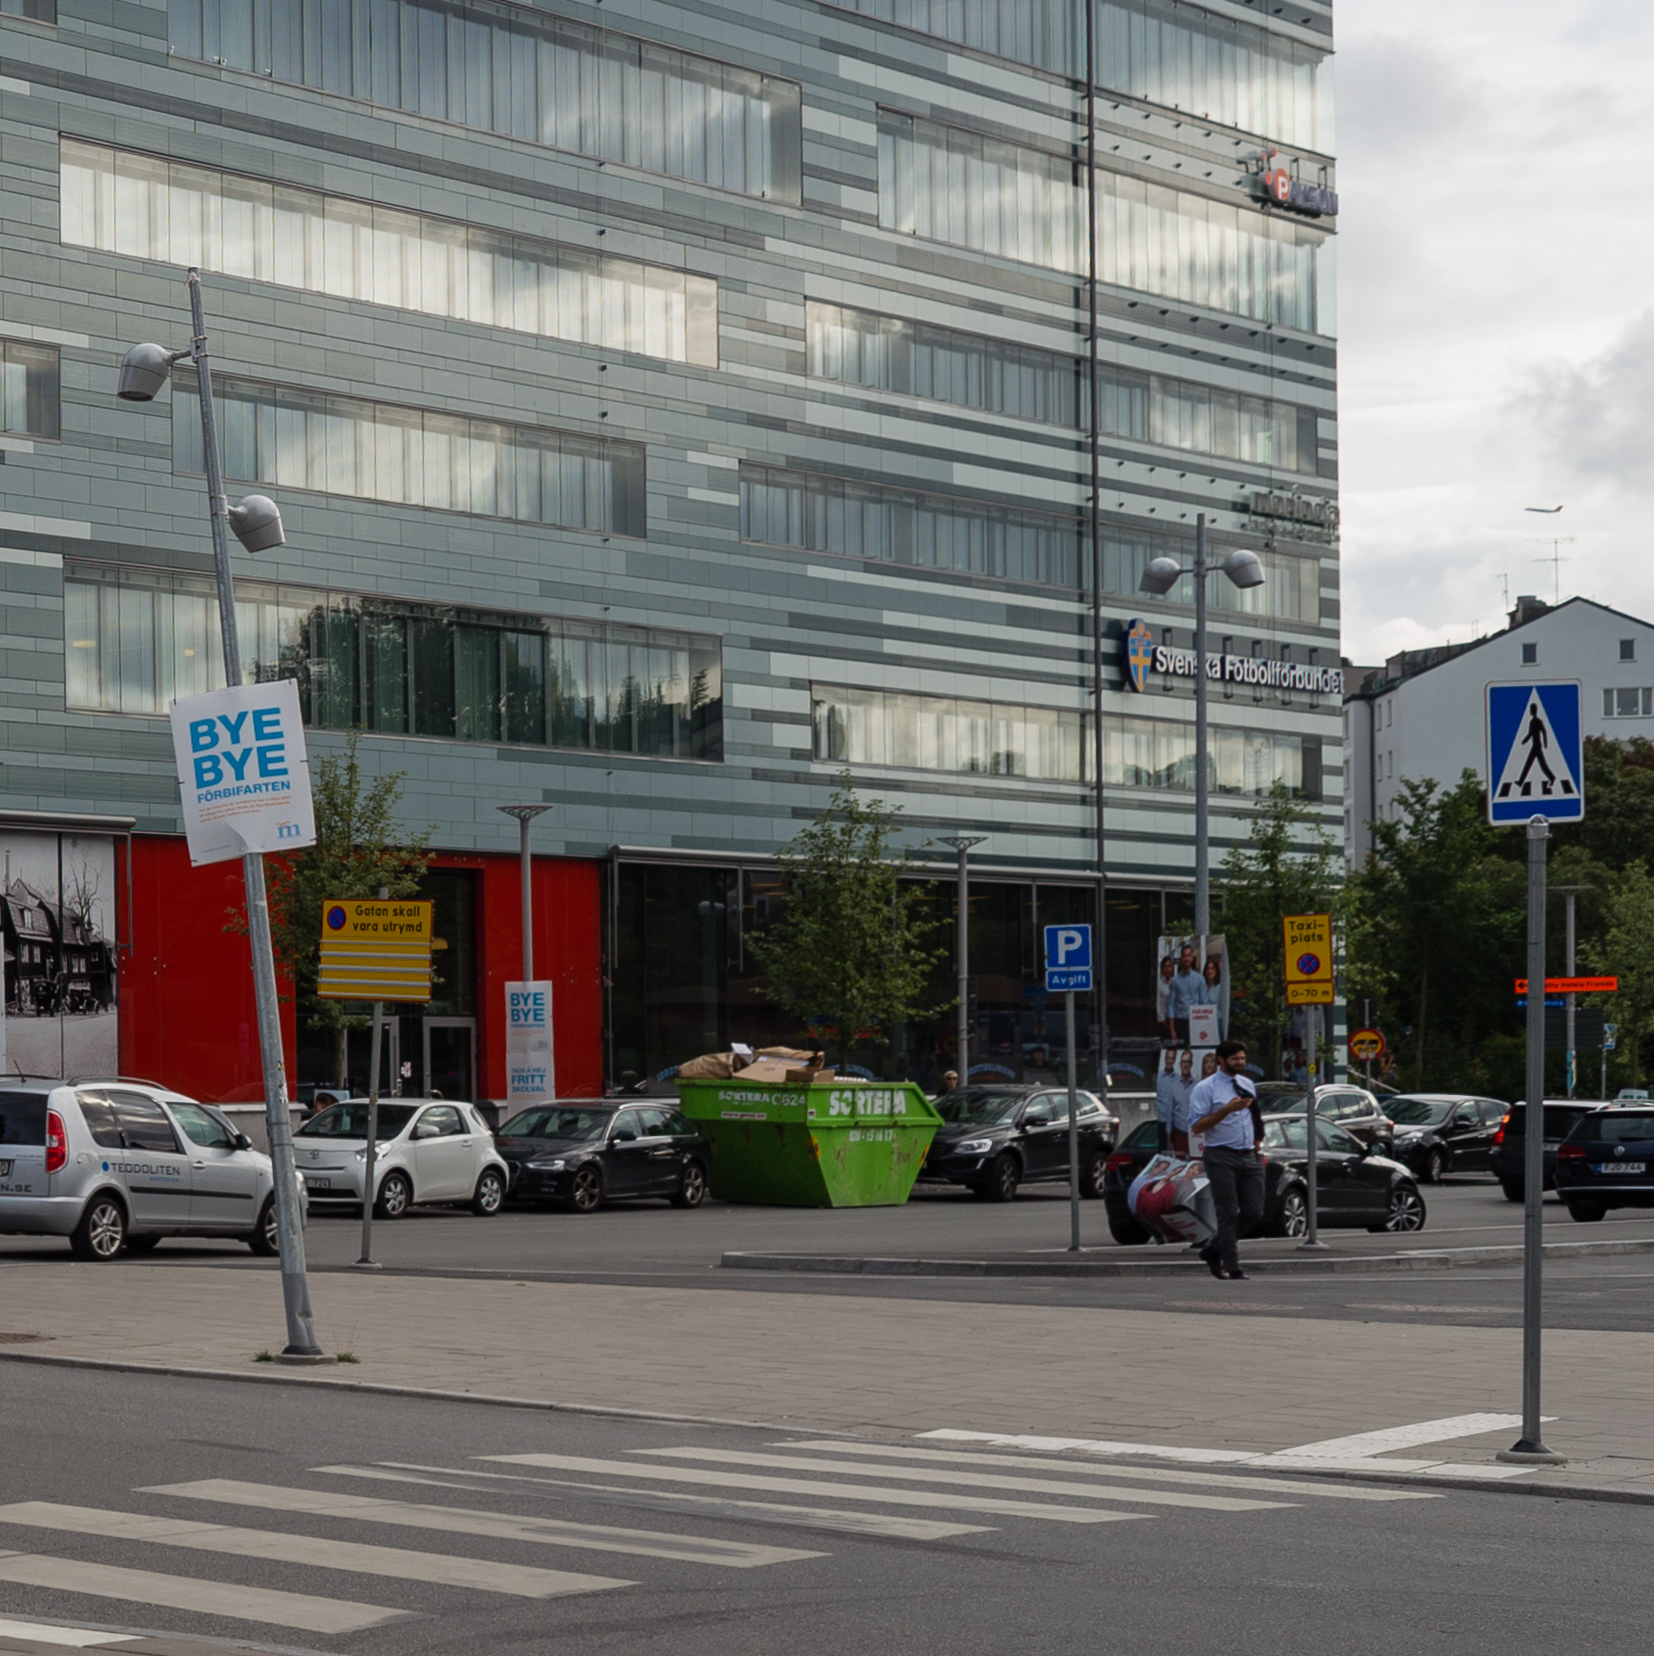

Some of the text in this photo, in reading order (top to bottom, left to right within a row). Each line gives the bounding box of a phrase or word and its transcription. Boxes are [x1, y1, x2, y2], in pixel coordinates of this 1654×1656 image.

[1224, 654, 1345, 694] Fotbollförbundet
[189, 707, 285, 753] BYE
[193, 744, 289, 790] BYE
[197, 780, 291, 804] FÖRBIFARTEN
[355, 905, 421, 917] Gatan skall
[353, 922, 423, 934] vara utrymd
[1289, 920, 1325, 931] Taxi-
[1291, 933, 1324, 945] plats
[1057, 930, 1083, 965] P
[1052, 975, 1087, 986] Avgift
[510, 992, 544, 1006] BYE
[1291, 989, 1318, 997] 0-70
[511, 1008, 545, 1022] BYE
[511, 1074, 546, 1085] FRITT
[829, 1090, 907, 1116] SORTERA
[111, 1162, 180, 1175] TEODOLITEN
